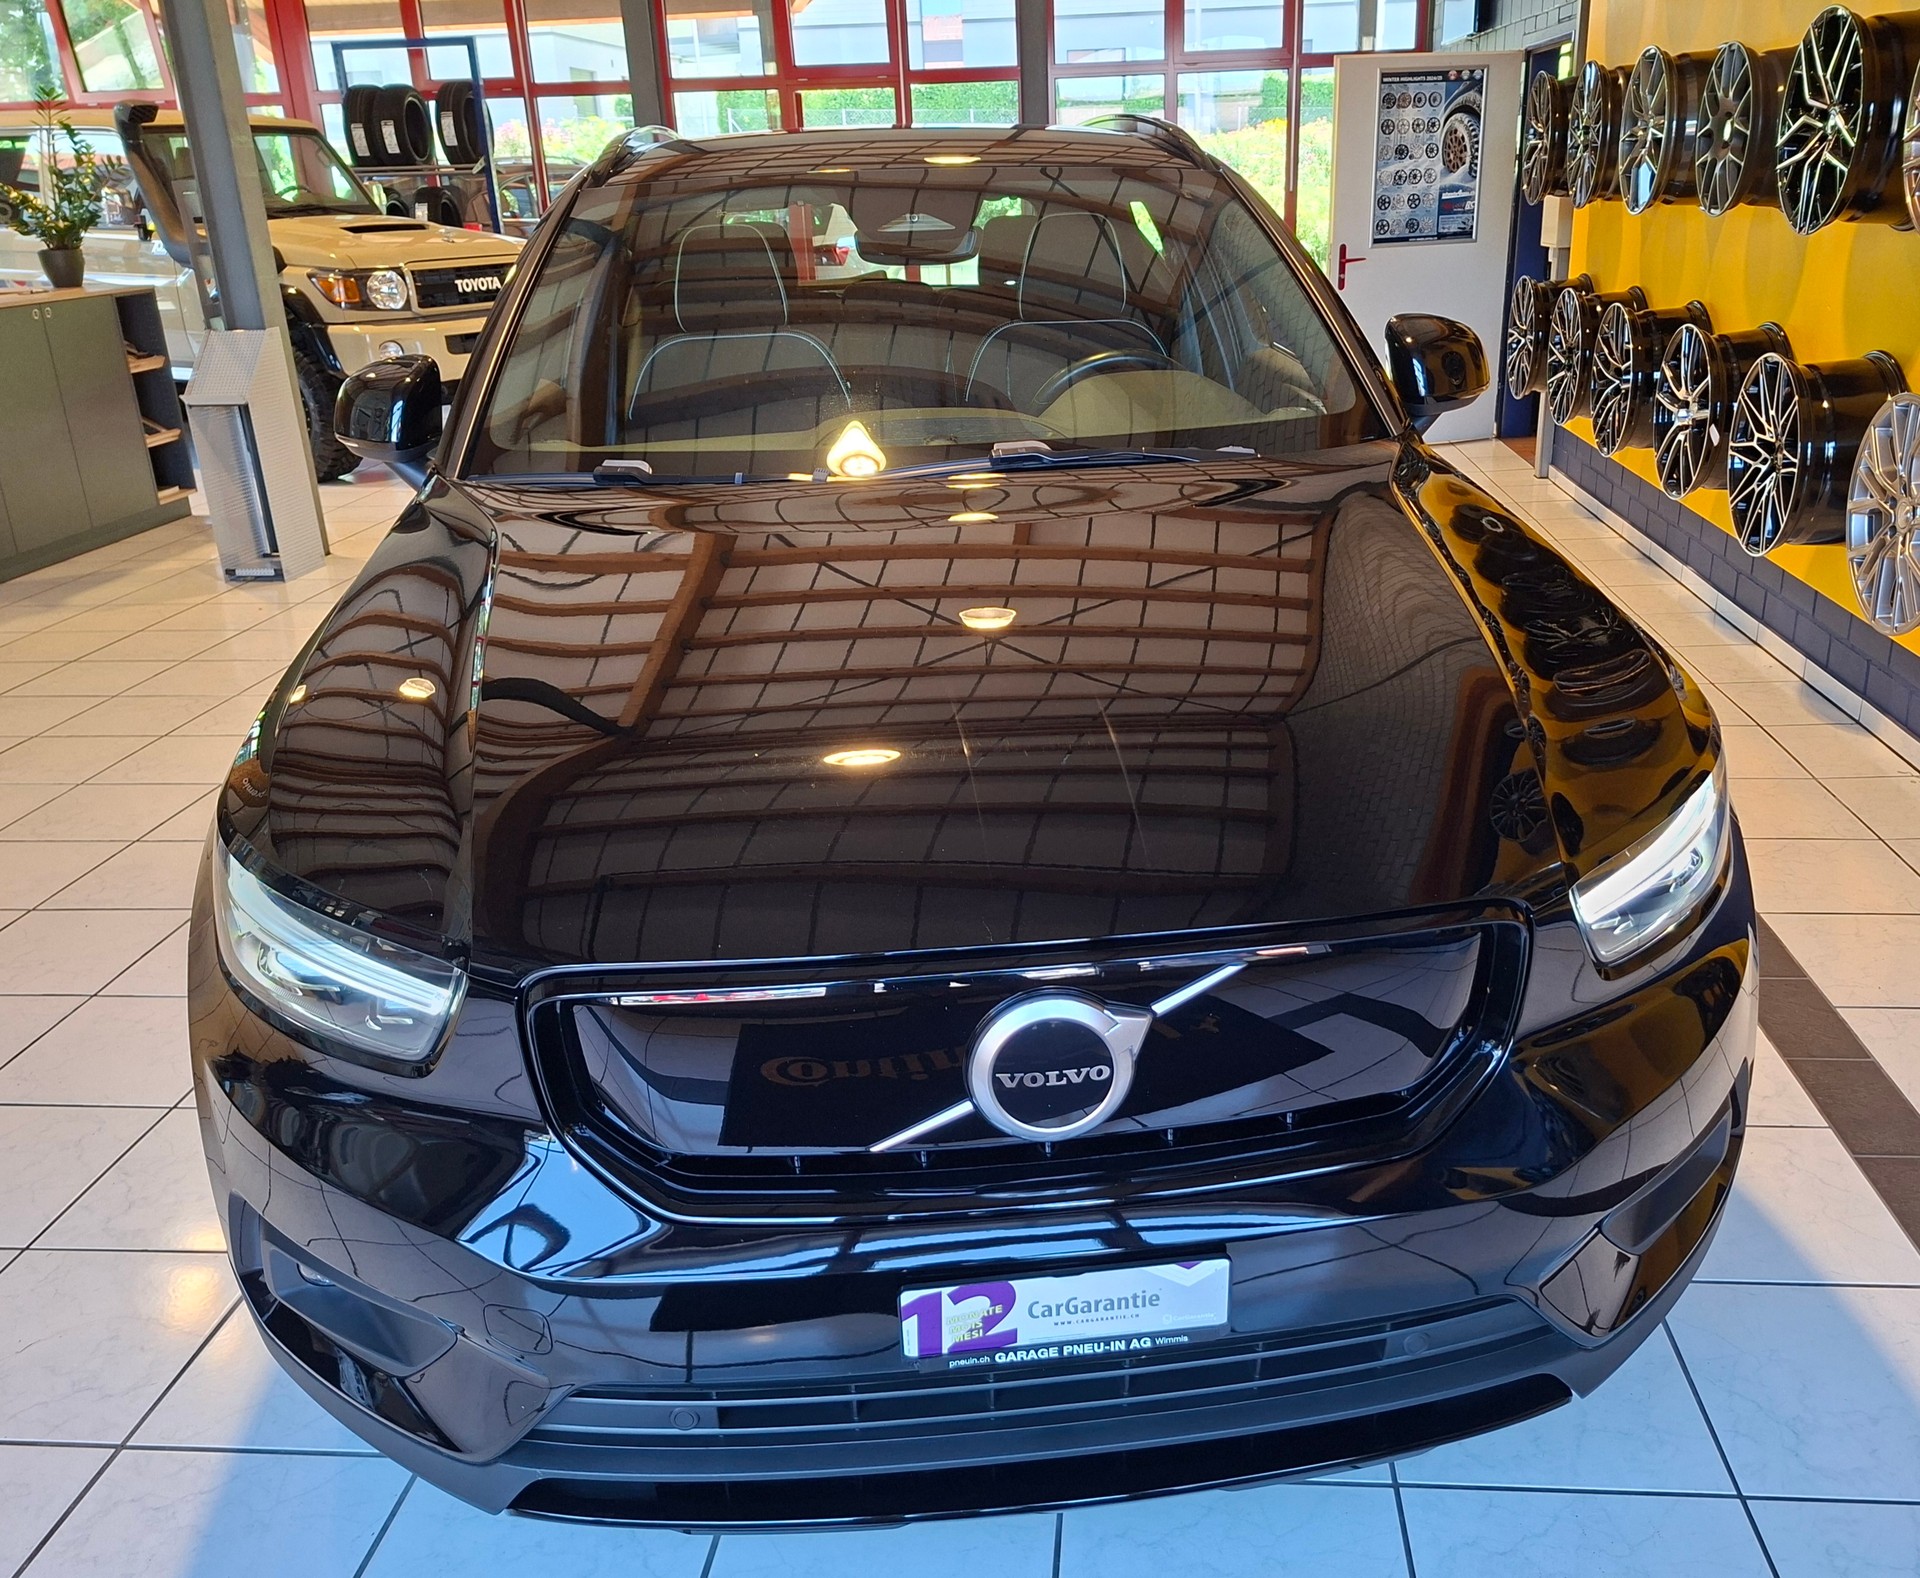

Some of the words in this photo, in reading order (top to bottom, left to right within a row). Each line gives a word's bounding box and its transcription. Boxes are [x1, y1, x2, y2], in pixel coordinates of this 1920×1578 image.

[455, 277, 501, 293] TOYOTA
[996, 1065, 1110, 1088] VOLVO
[948, 1304, 1003, 1324] MONATE
[1028, 1290, 1161, 1319] CarGarantie
[901, 1281, 1017, 1358] 12
[951, 1320, 983, 1334] MOIS
[953, 1329, 984, 1343] MESI
[949, 1355, 991, 1369] pneuin.ch
[994, 1346, 1059, 1363] GARAGE
[1063, 1340, 1126, 1357] PNEU-IN
[1129, 1337, 1152, 1350] AG
[1155, 1333, 1189, 1345] Wimmis
